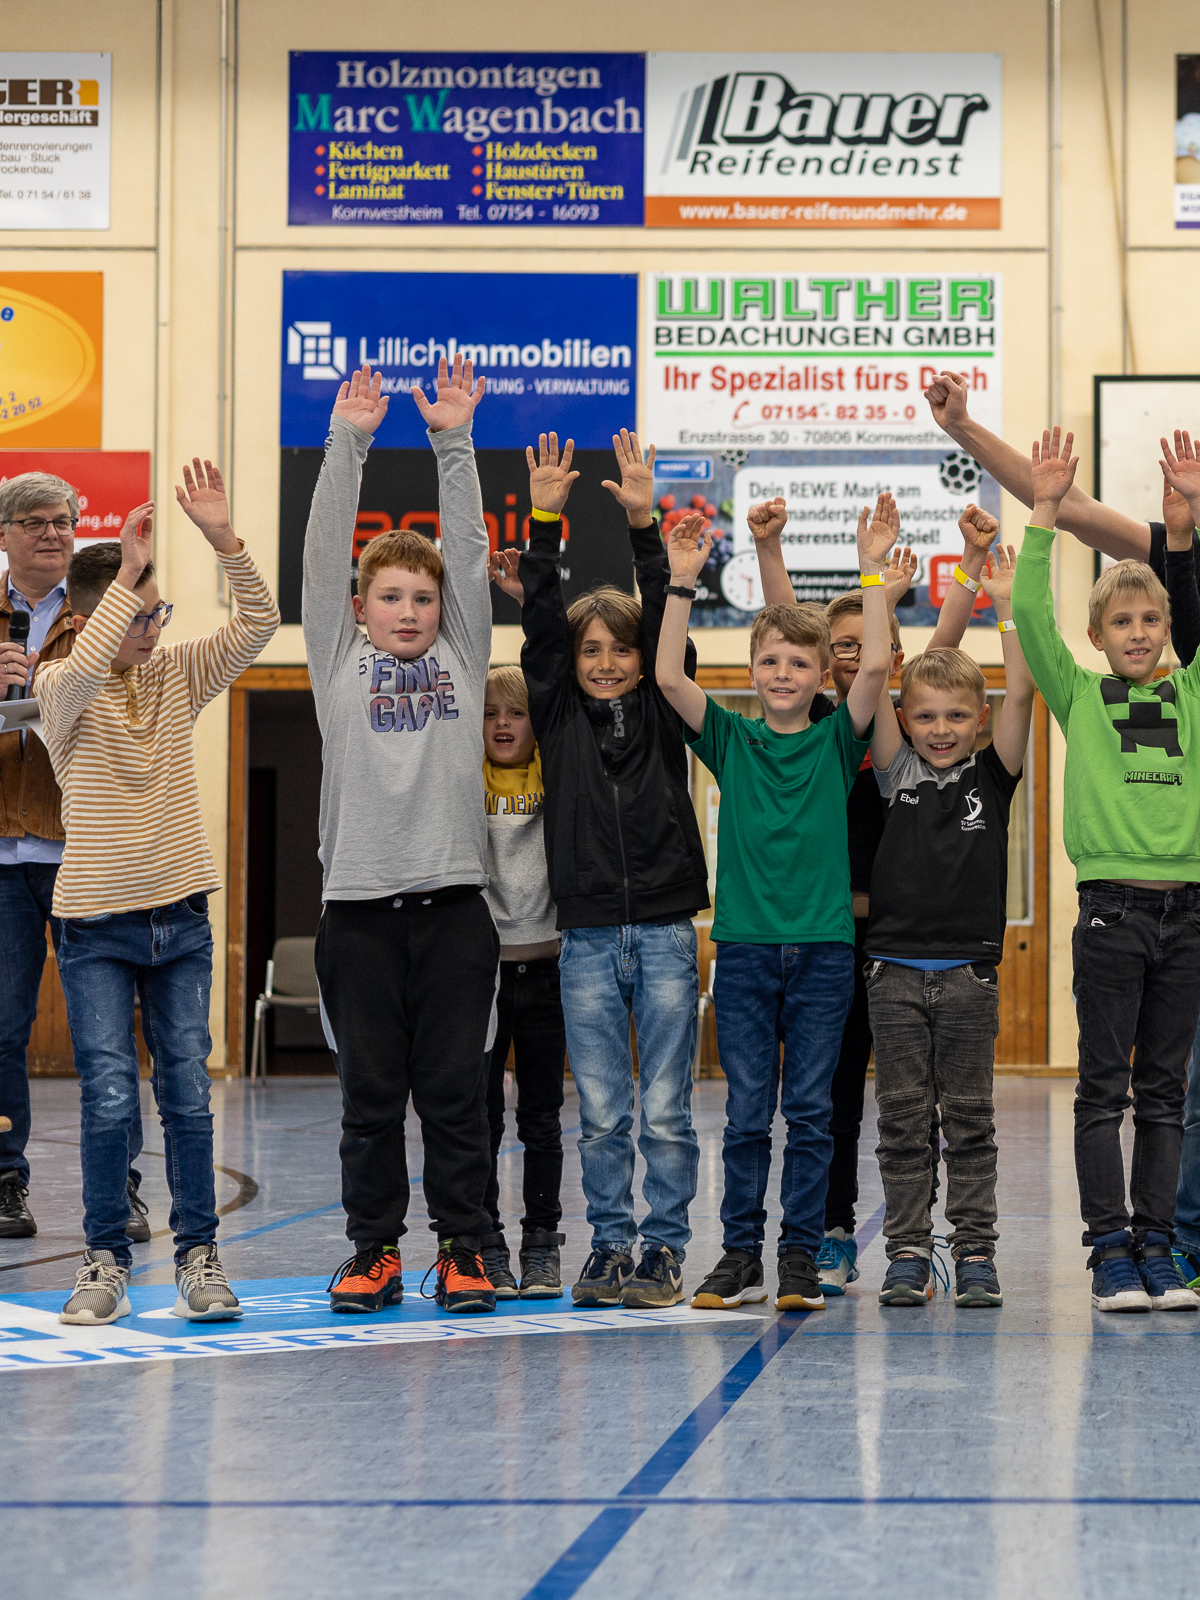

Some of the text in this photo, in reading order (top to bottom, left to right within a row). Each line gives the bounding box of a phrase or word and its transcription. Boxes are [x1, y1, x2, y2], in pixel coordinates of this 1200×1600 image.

[336, 59, 602, 96] Holzmontagen
[0, 79, 73, 105] ER
[294, 88, 643, 142] Marc Wagenbach
[721, 72, 989, 146] Bauer
[31, 153, 61, 163] Stuck
[328, 141, 403, 160] Küchen
[486, 142, 598, 161] Holzdecken
[486, 163, 584, 180] Haustüren
[690, 149, 962, 176] Reifendienst
[328, 161, 450, 184] Fertigparkett
[328, 182, 405, 199] Laminat
[486, 183, 624, 200] Fenster+Türen
[332, 205, 443, 221] Kornwestheim
[457, 205, 481, 220] Tel.
[487, 205, 533, 220] 07154
[553, 205, 599, 220] 16093
[679, 202, 968, 221] www.bauer-reifenundmehr.de
[656, 278, 994, 321] WALTHER
[655, 326, 995, 346] BEDACHUNGEN GMBH
[534, 379, 630, 396] VERWALTUNG
[664, 365, 987, 397] Ihr Spezialist fürs Dch
[761, 404, 817, 420] 07154
[837, 404, 858, 420] 82
[866, 404, 886, 420] 35
[904, 404, 916, 420] 0
[679, 430, 958, 445] Enzstrasse 30 70806 Kornwesthe
[750, 482, 921, 498] Dein REWE Markt am
[898, 529, 941, 546] Spiel!
[1124, 771, 1183, 786] MINECRAFT
